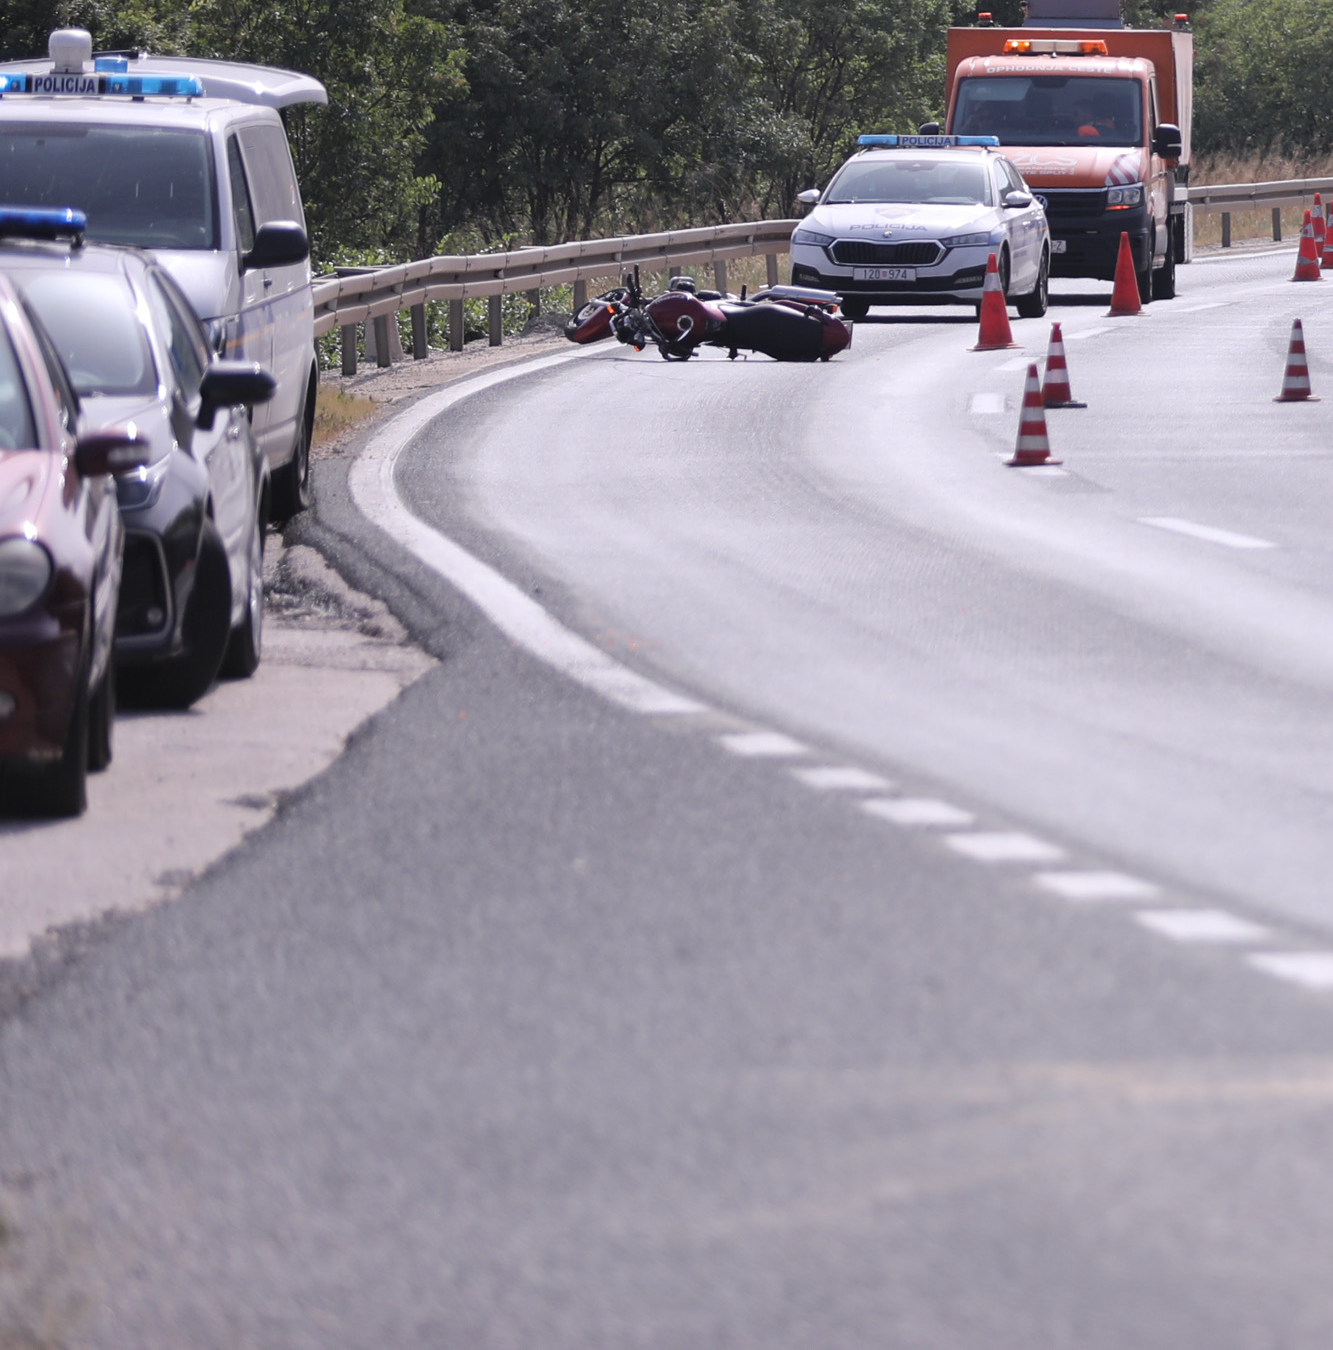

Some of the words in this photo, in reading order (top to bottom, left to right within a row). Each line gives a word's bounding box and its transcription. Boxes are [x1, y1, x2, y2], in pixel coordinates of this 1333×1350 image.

[986, 65, 1064, 74] OPHODNJA
[1068, 66, 1112, 74] CESTE
[34, 77, 95, 93] POLICIJA
[901, 136, 952, 146] POLICIJA
[849, 223, 928, 232] POLICIJA
[863, 268, 880, 279] 120
[888, 268, 907, 279] 974
